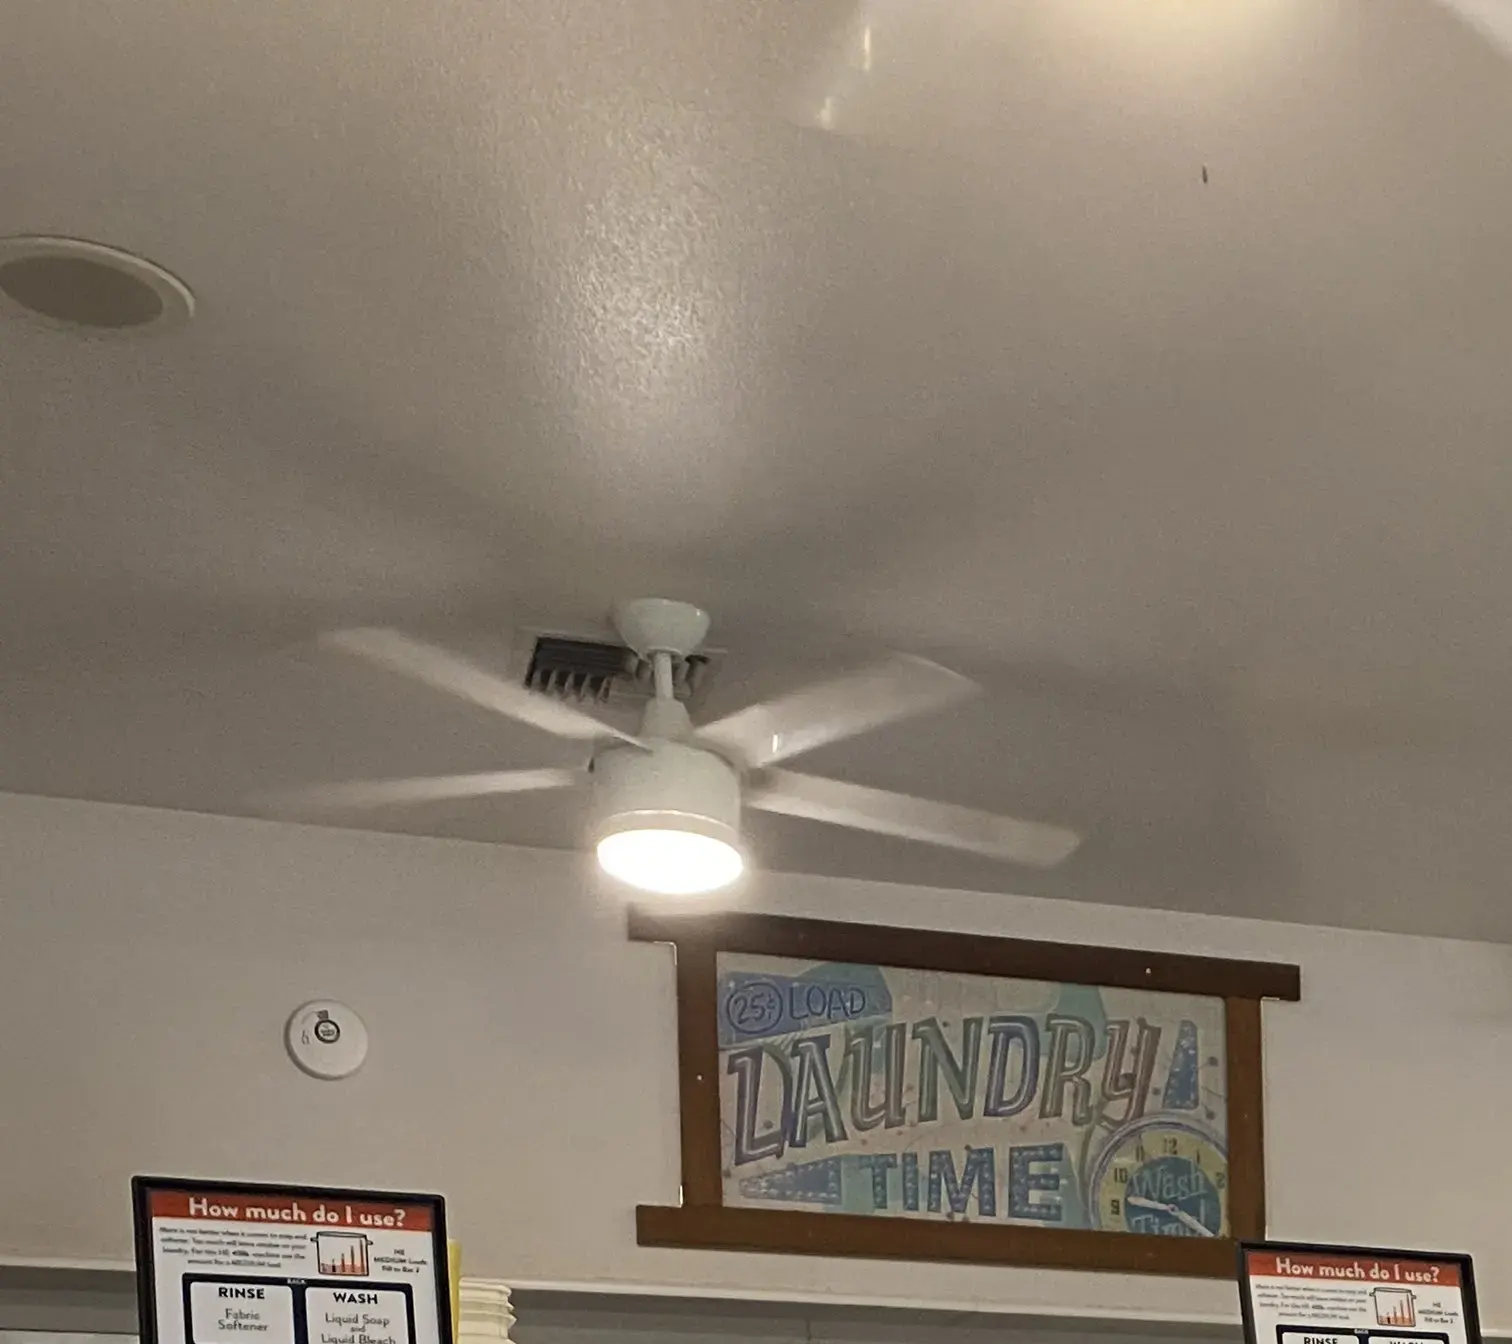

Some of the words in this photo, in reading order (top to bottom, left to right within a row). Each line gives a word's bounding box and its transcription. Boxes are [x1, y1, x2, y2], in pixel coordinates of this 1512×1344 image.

[789, 985, 866, 1019] LOAD
[727, 1013, 1162, 1166] LAUNDRY
[865, 1143, 1063, 1221] TIME
[1113, 1167, 1127, 1184] 10
[188, 1197, 239, 1217] How
[246, 1202, 306, 1222] much
[312, 1204, 339, 1223] do
[346, 1206, 351, 1223] I
[359, 1209, 406, 1227] use?
[1276, 1257, 1313, 1274] How
[1319, 1262, 1365, 1278] much
[1369, 1263, 1390, 1279] do
[1395, 1264, 1400, 1279] I
[1405, 1266, 1440, 1283] use?
[218, 1287, 265, 1299] RINSE
[333, 1292, 378, 1304] WASH
[225, 1308, 260, 1320] Fabric
[325, 1312, 358, 1326] Liquid
[362, 1314, 390, 1327] Soap
[218, 1320, 268, 1331] Softener
[359, 1334, 396, 1344] Bleach
